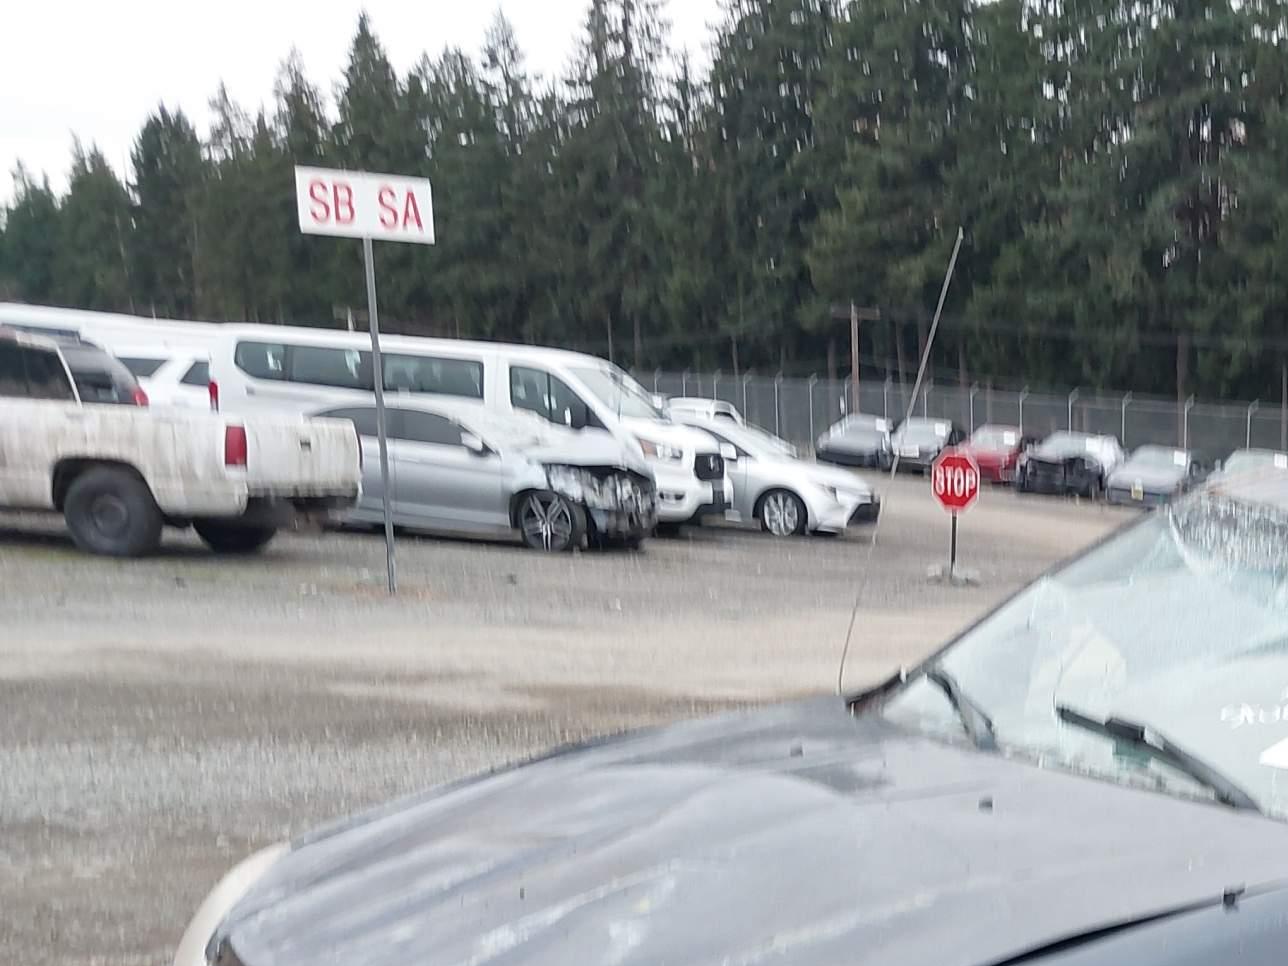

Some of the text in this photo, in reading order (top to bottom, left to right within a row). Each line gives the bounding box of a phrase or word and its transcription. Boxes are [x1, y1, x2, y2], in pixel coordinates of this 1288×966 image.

[308, 179, 424, 231] SB SA
[935, 465, 976, 498] STOP
